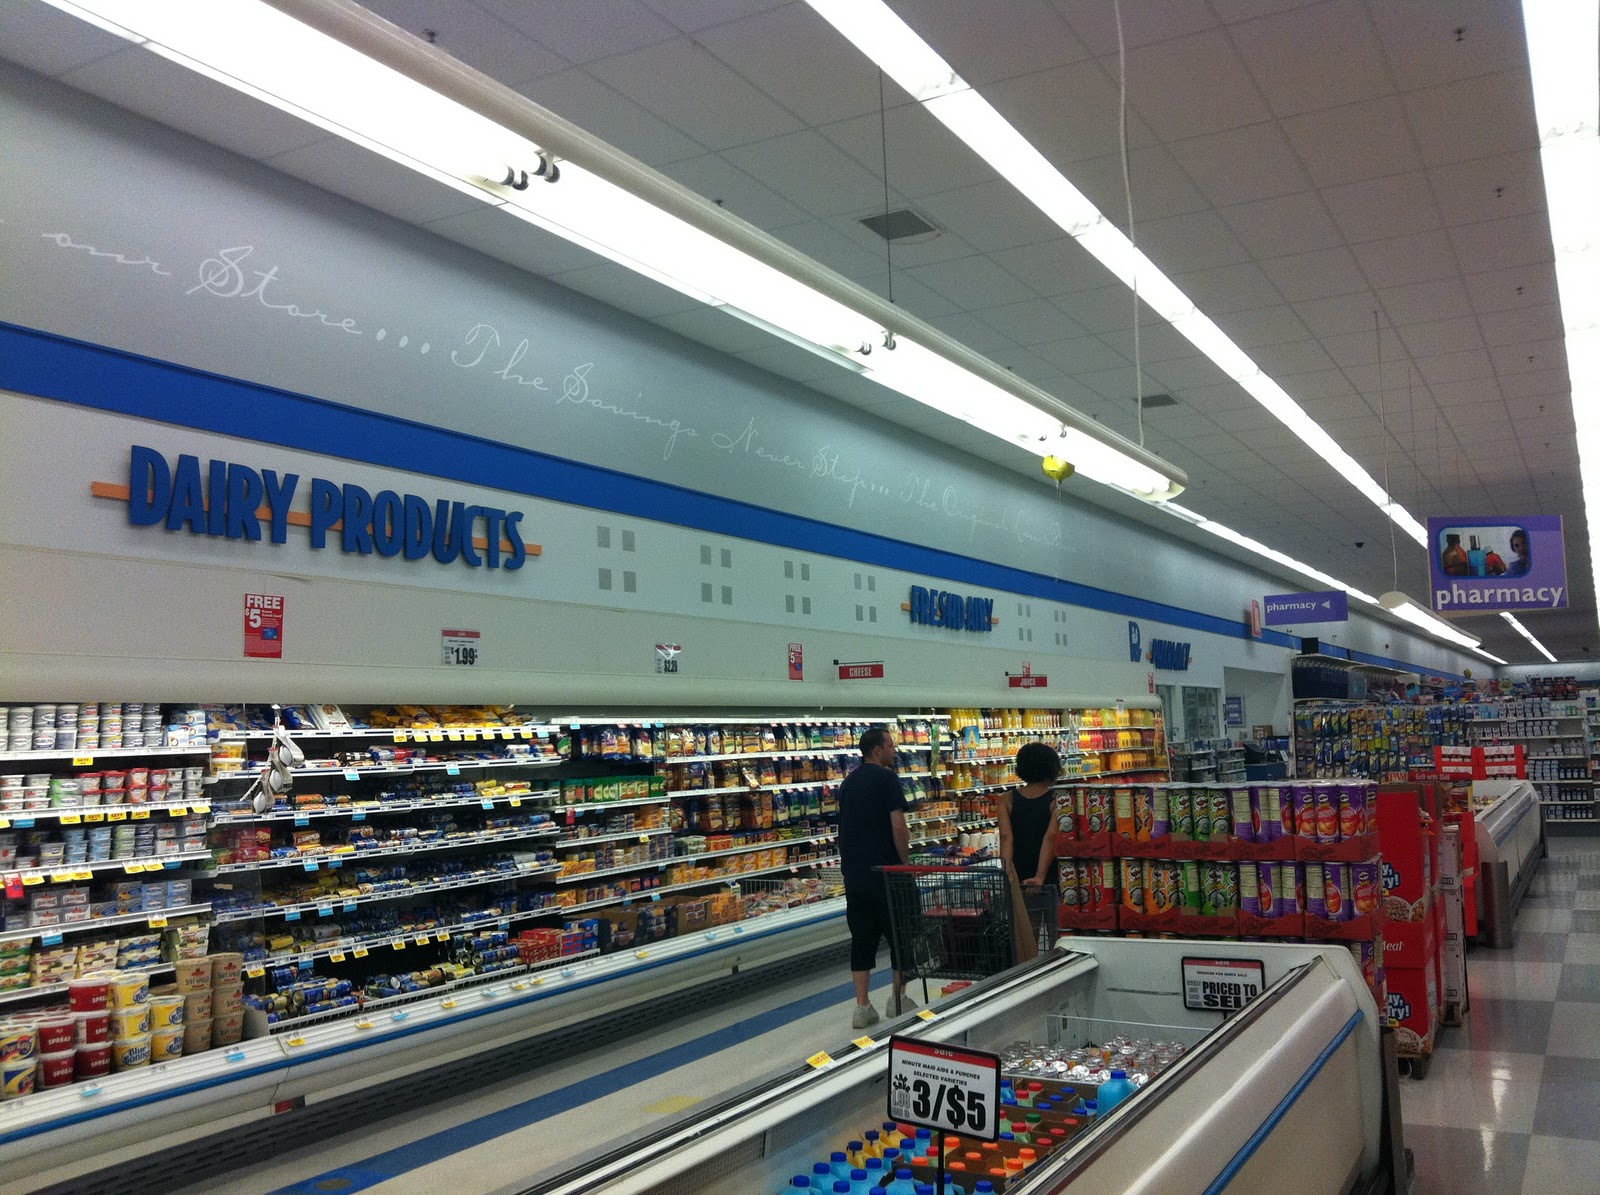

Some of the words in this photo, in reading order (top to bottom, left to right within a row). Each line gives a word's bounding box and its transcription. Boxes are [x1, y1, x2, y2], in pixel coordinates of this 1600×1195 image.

[451, 323, 549, 391] The
[556, 362, 699, 461] Savings
[711, 416, 805, 469] Never
[129, 444, 299, 545] DAIRY
[311, 477, 525, 570] PRODUCTS
[246, 594, 282, 610] FREE
[1436, 583, 1564, 610] pharmacy
[1266, 602, 1317, 613] pharmacy
[848, 666, 873, 678] CHEESE
[1382, 874, 1400, 889] ry!
[1202, 981, 1241, 996] PRICED
[1242, 983, 1258, 996] TO
[129, 1046, 147, 1058] Blue
[901, 1059, 922, 1068] MINUTE
[955, 1069, 980, 1080] PUNCHES
[913, 1070, 939, 1081] SELECTED
[940, 1075, 968, 1086] VARIETIES
[912, 1079, 986, 1132] 3/$5
